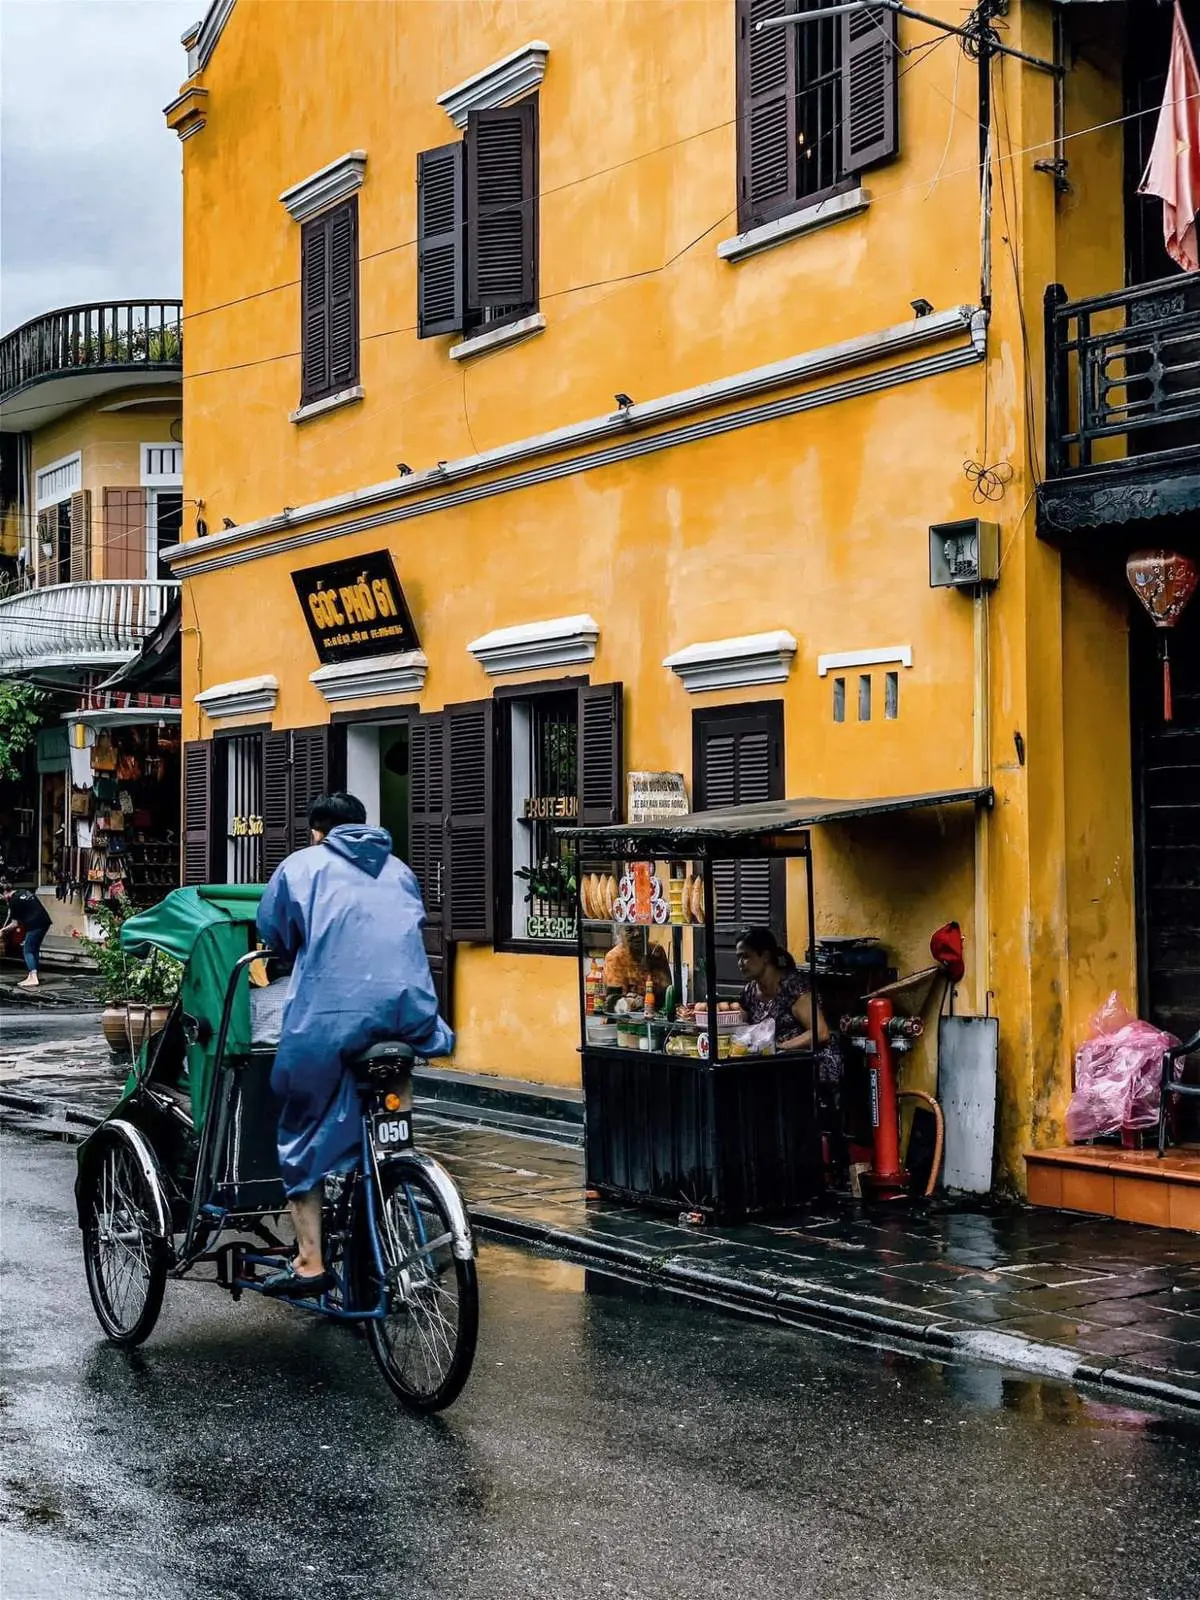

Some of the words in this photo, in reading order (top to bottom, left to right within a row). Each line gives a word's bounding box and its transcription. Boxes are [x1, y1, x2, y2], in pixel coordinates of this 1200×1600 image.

[371, 578, 398, 618] 61
[523, 796, 556, 819] FRUIT
[378, 1119, 409, 1144] 050
